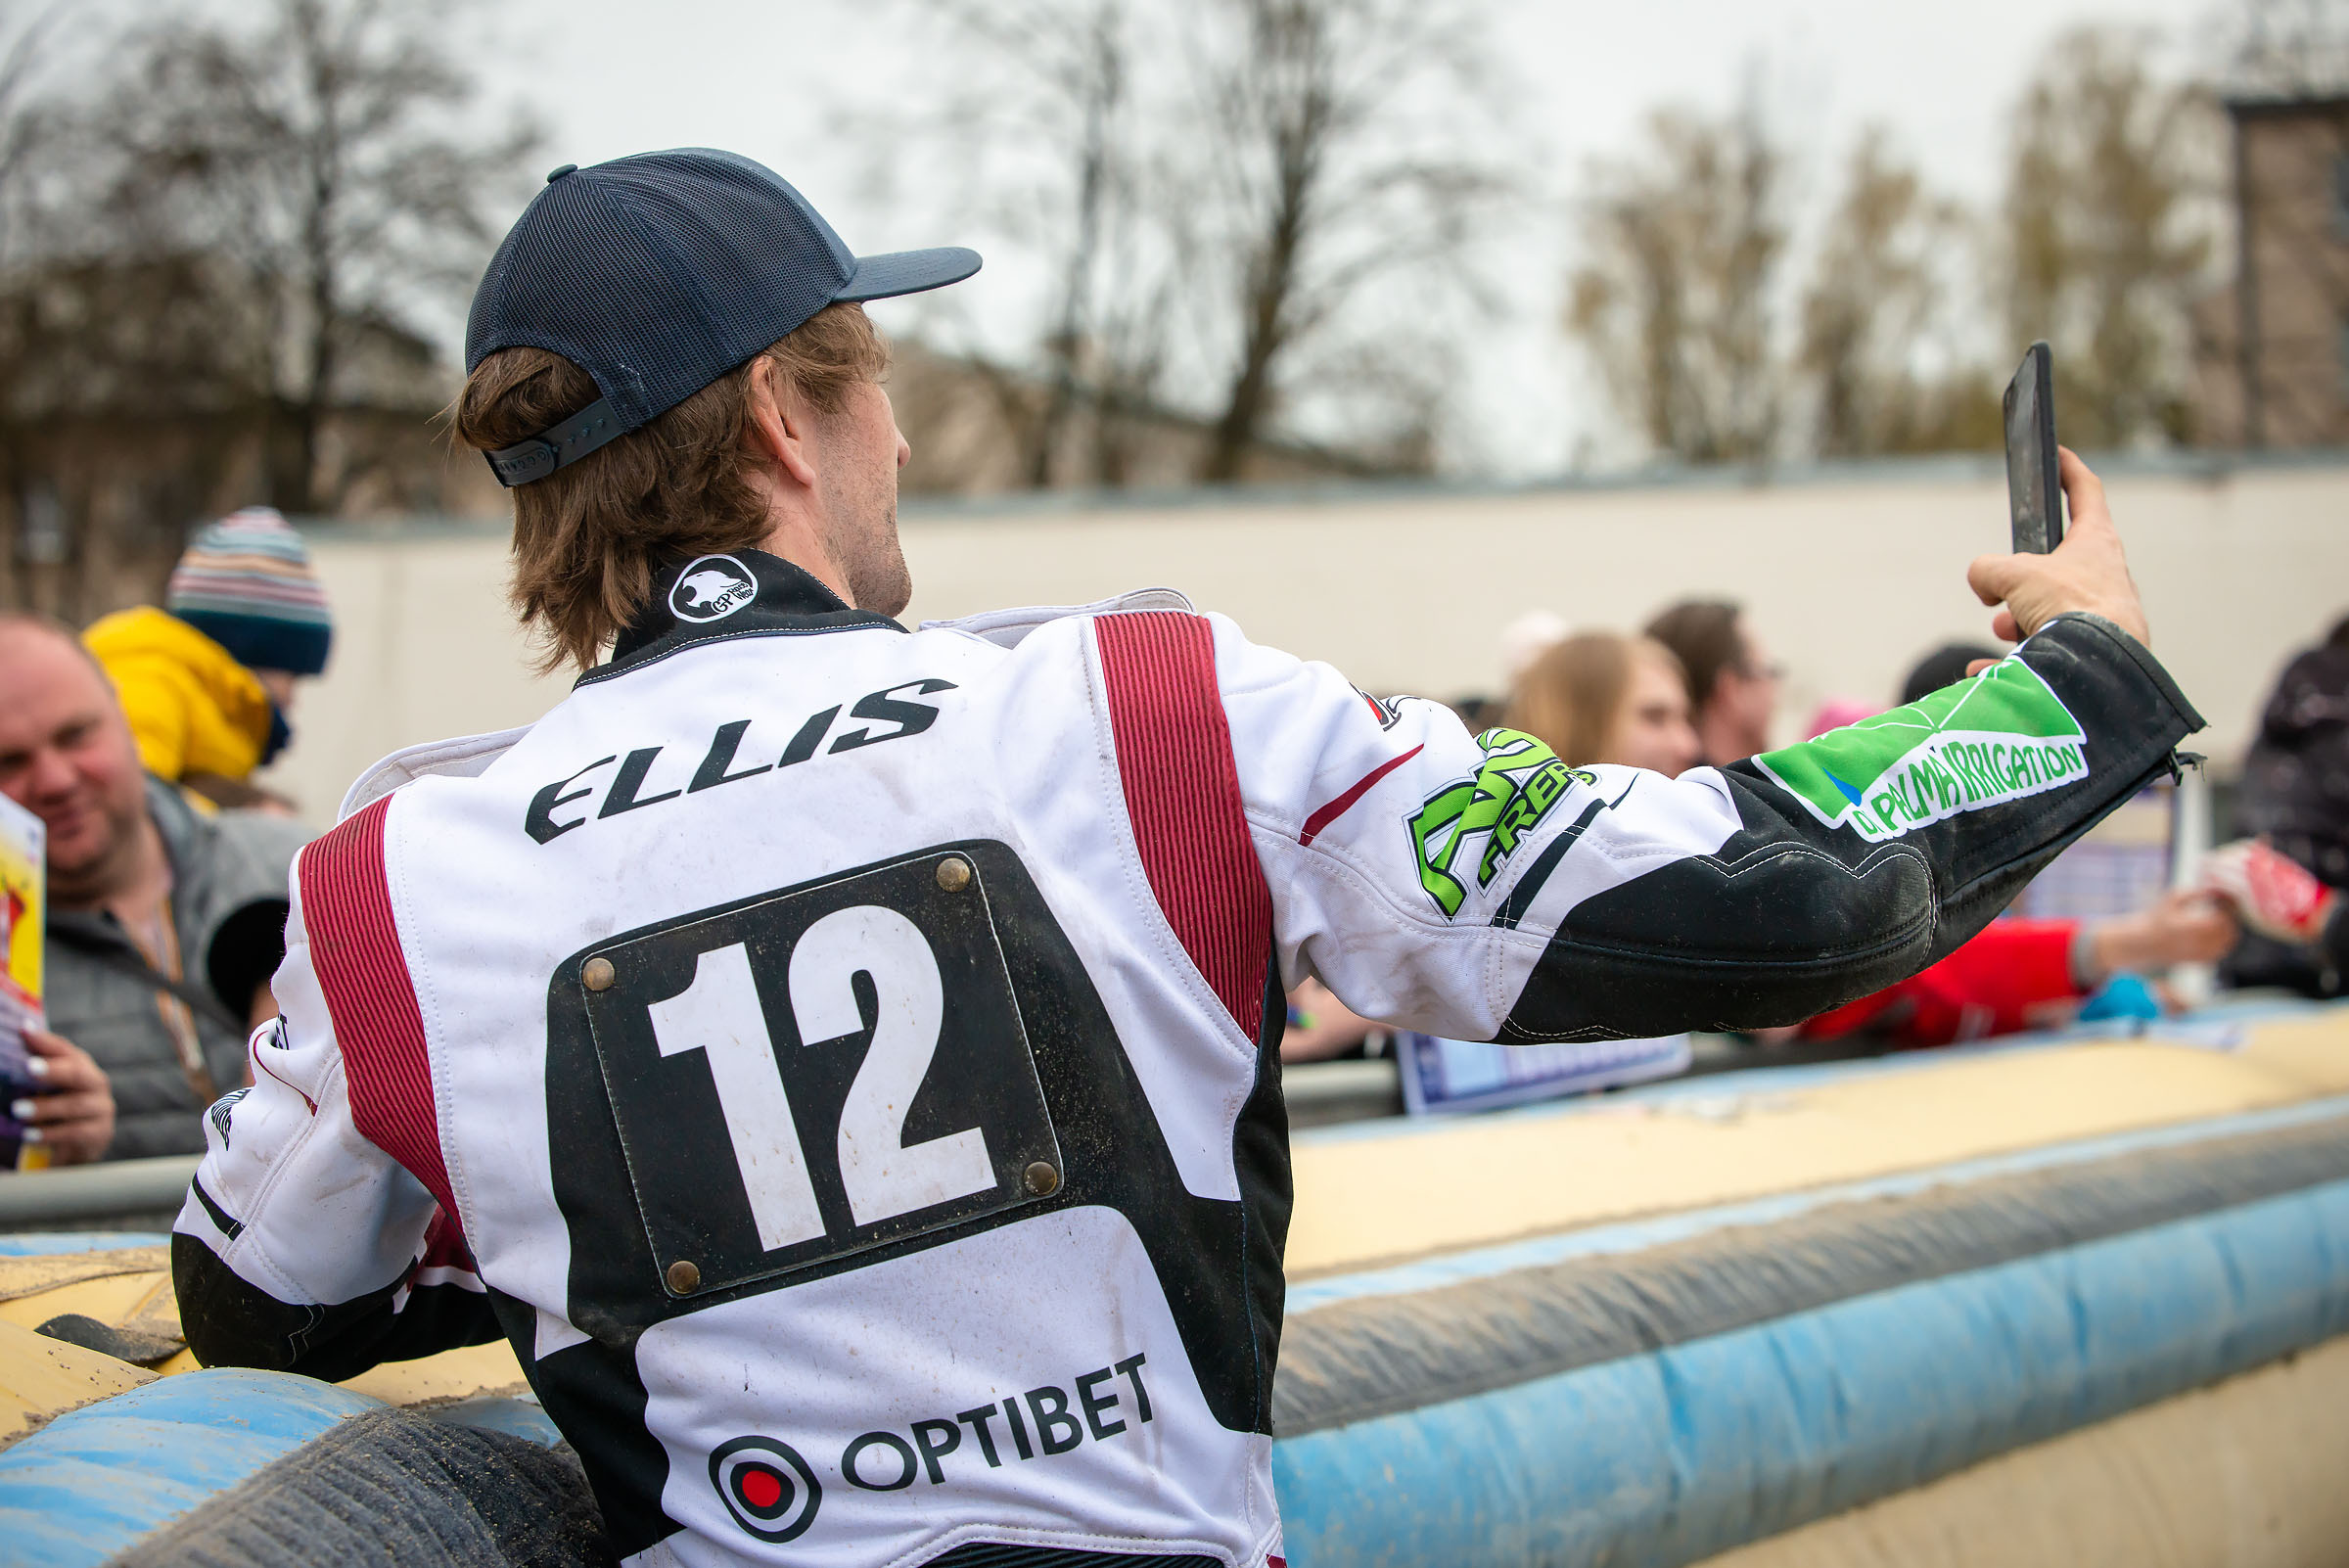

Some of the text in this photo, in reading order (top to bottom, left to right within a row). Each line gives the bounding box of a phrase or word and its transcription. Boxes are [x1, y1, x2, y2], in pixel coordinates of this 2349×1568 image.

[713, 593, 733, 613] GP
[525, 678, 959, 845] ELLIS
[1870, 753, 1960, 832] PALMA
[1940, 740, 2083, 804] IRRIGATION
[647, 904, 997, 1253] 12
[841, 1352, 1154, 1492] OPTIBET
